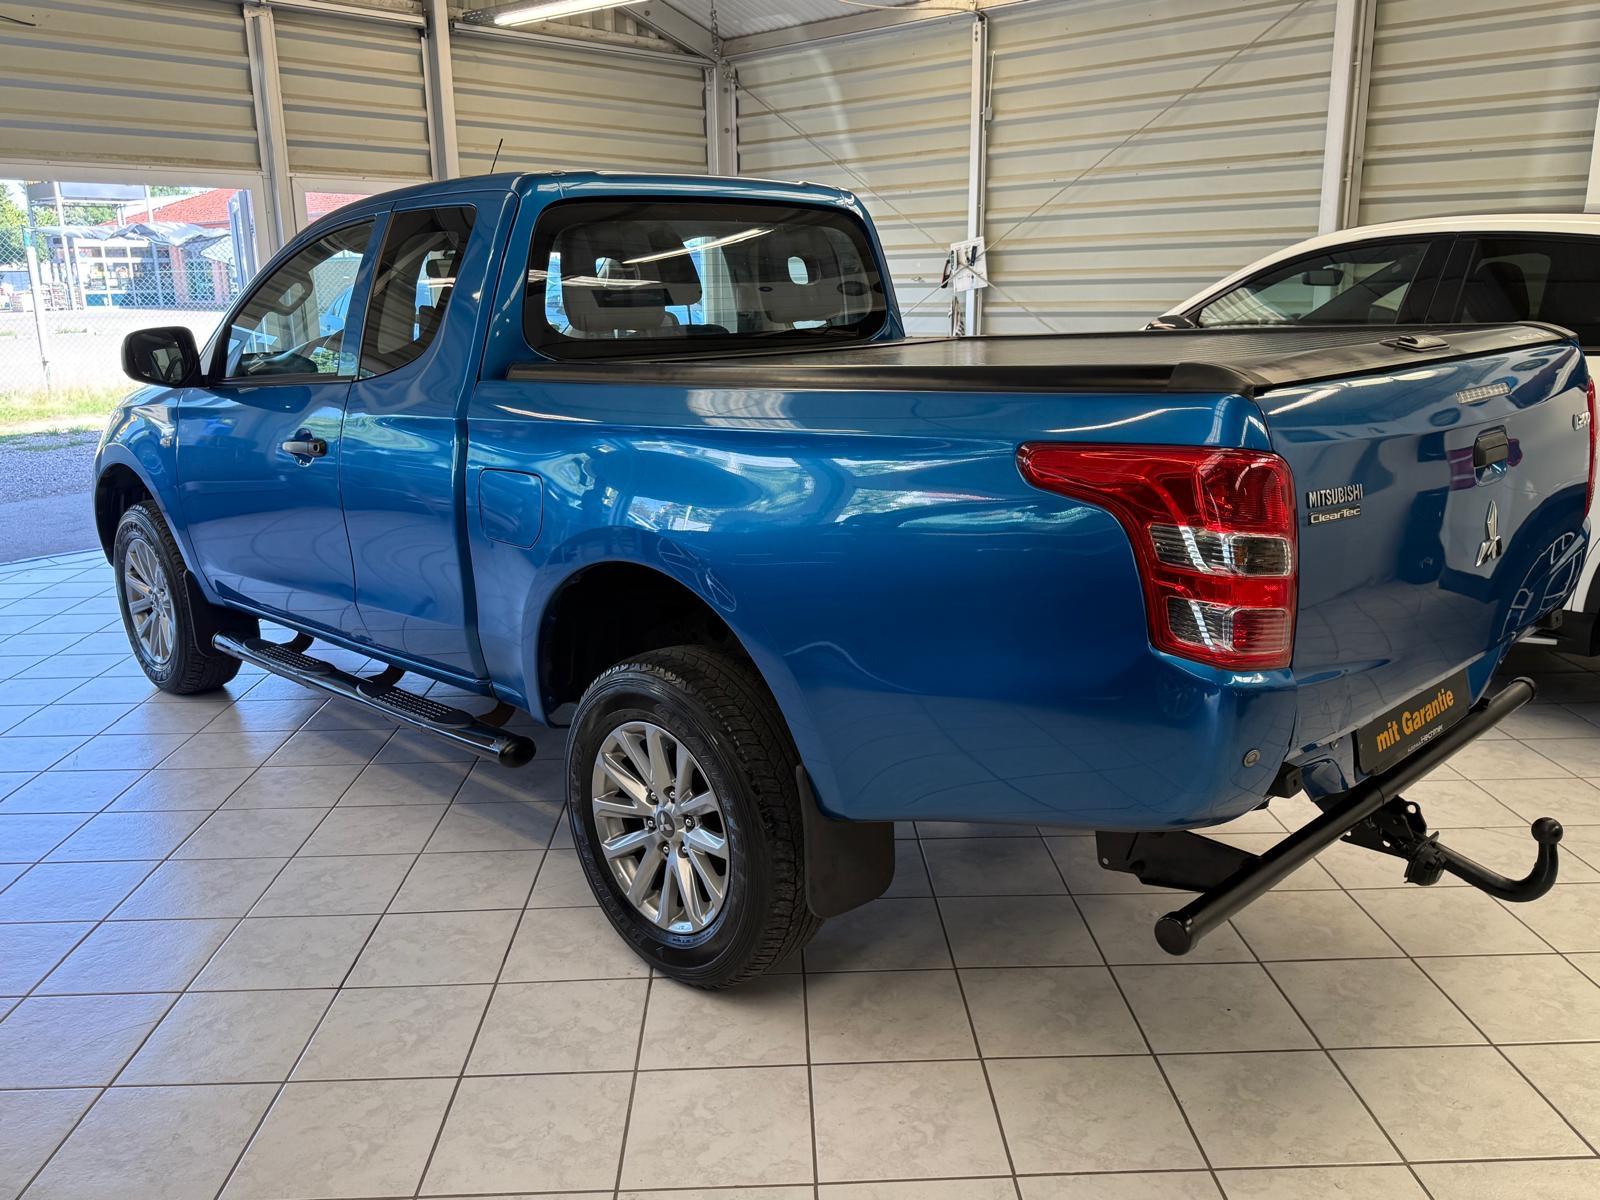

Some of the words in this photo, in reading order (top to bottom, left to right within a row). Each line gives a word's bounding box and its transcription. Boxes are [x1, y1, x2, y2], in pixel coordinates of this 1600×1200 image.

[1308, 483, 1363, 508] MITSUBISHI
[1310, 508, 1361, 524] ClearTec
[1376, 720, 1400, 752] mit
[1402, 688, 1454, 735] Garantie
